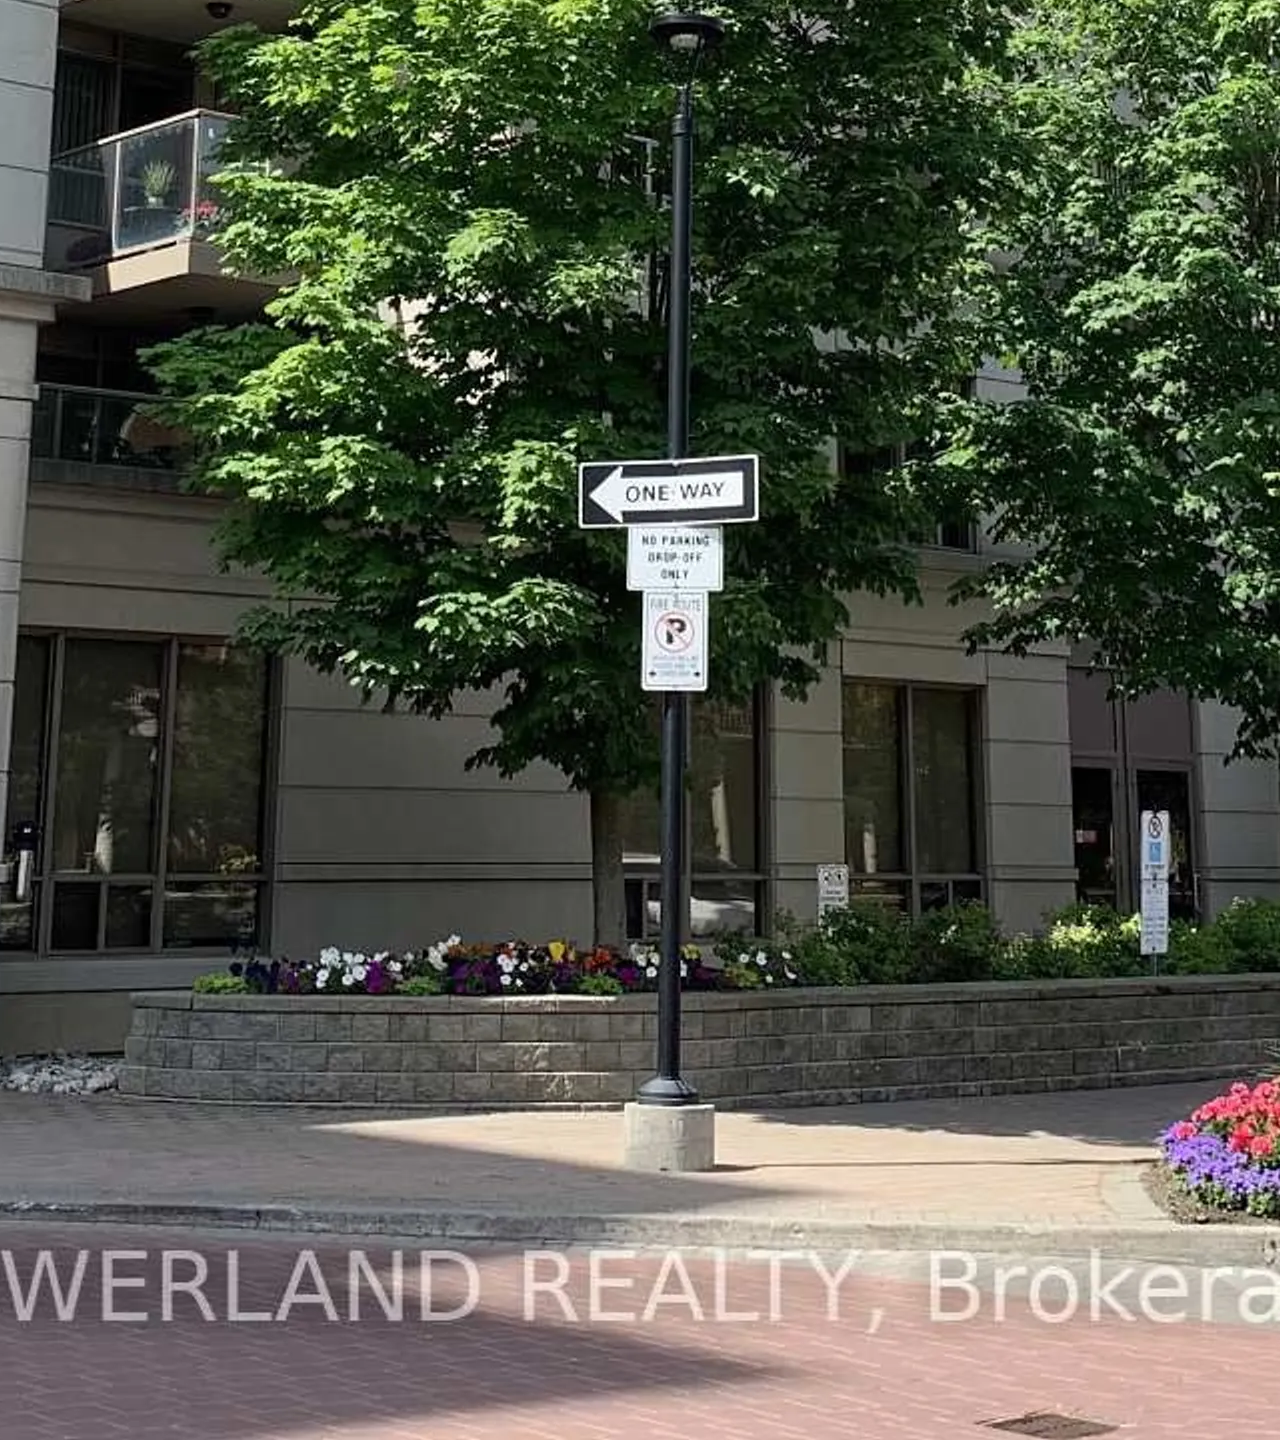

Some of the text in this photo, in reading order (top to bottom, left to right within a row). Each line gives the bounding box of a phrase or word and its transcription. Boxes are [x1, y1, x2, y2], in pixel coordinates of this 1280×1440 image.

[625, 481, 725, 503] ONE WAY
[641, 534, 710, 546] NO PARKING
[660, 569, 689, 580] ONLY
